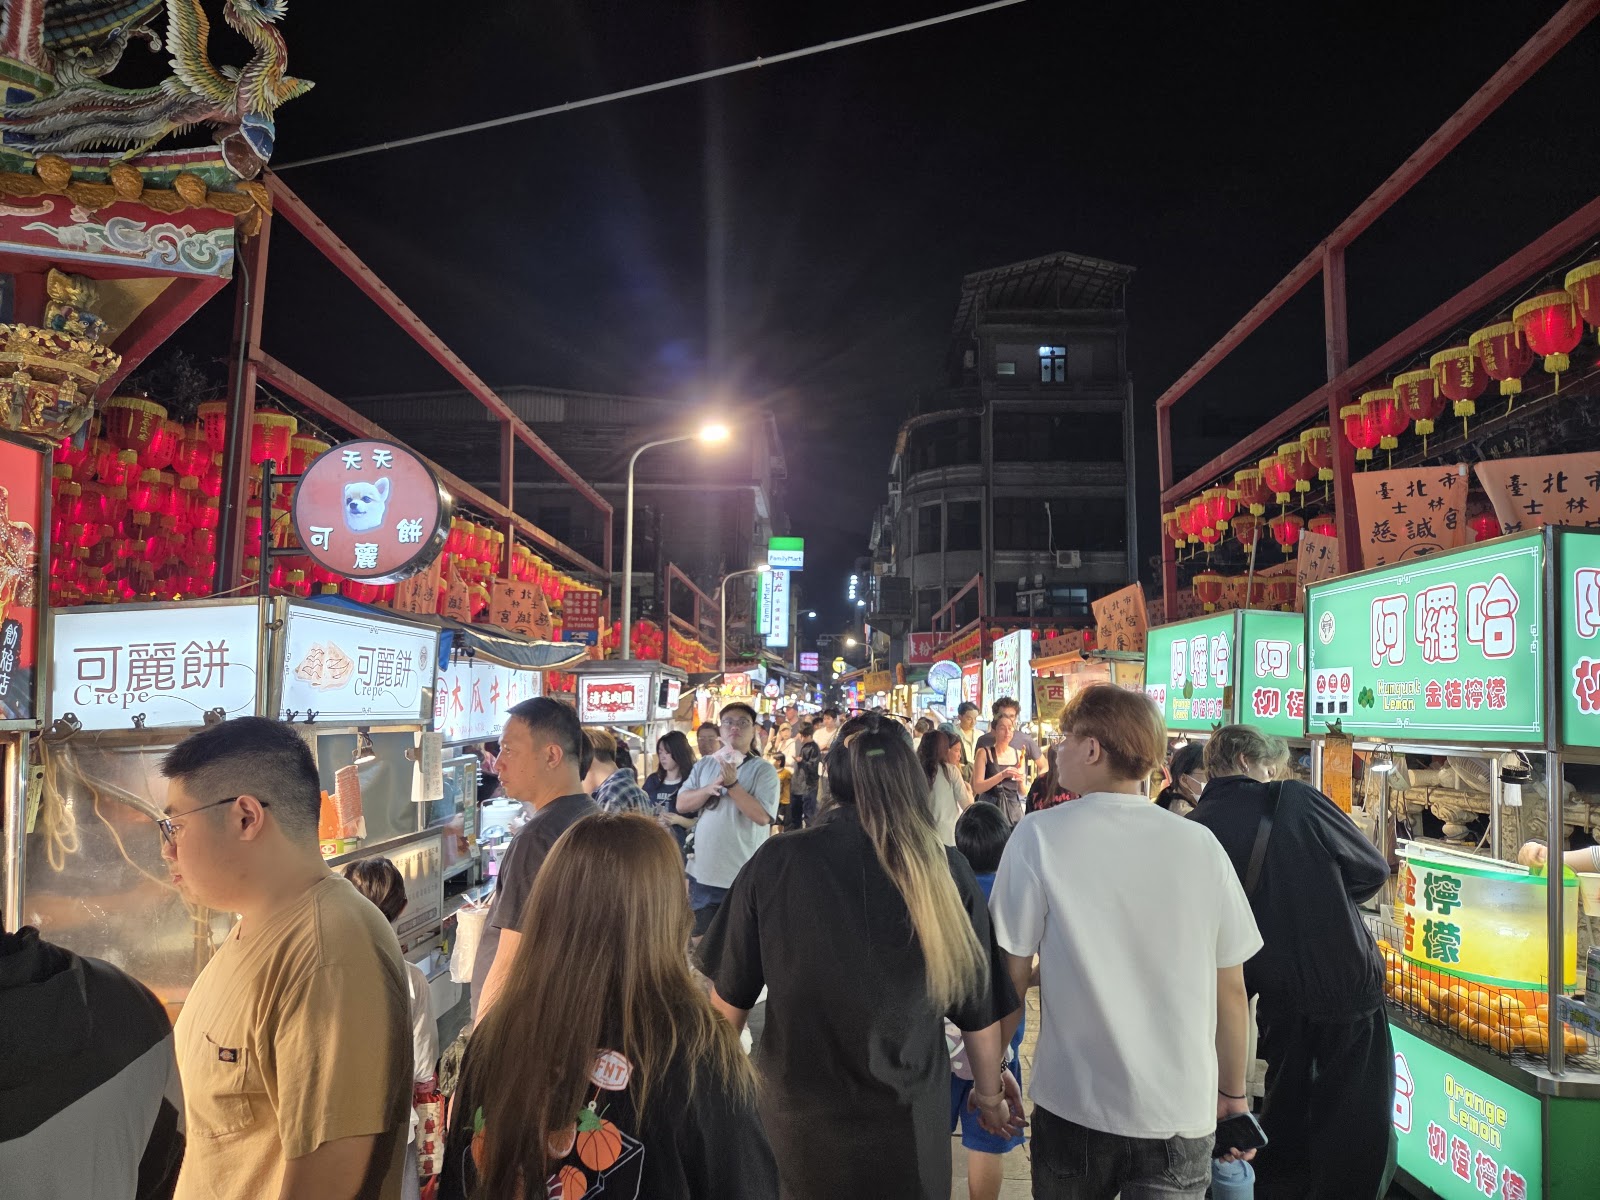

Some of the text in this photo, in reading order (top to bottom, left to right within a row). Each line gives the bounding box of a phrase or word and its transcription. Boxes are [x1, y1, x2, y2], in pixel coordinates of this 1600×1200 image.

[341, 449, 393, 470] 天天
[1375, 472, 1460, 500] 臺北市
[1392, 496, 1445, 514] 士林
[1523, 497, 1589, 515] 士林
[309, 517, 423, 569] 可麗餅
[1371, 574, 1519, 668] 阿囉哈
[73, 639, 230, 693] 可麗餅
[357, 645, 412, 688] 可麗餅
[1171, 631, 1230, 690] 阿囉哈
[1255, 639, 1304, 678] 阿
[73, 682, 150, 710] Crepe
[354, 677, 383, 701] Crepe
[1383, 696, 1415, 711] Lemon
[1425, 676, 1507, 709] 金桔檸檬
[1422, 871, 1462, 964] 檸檬
[1444, 1073, 1507, 1129] Orange
[1448, 1098, 1502, 1151] Lemon
